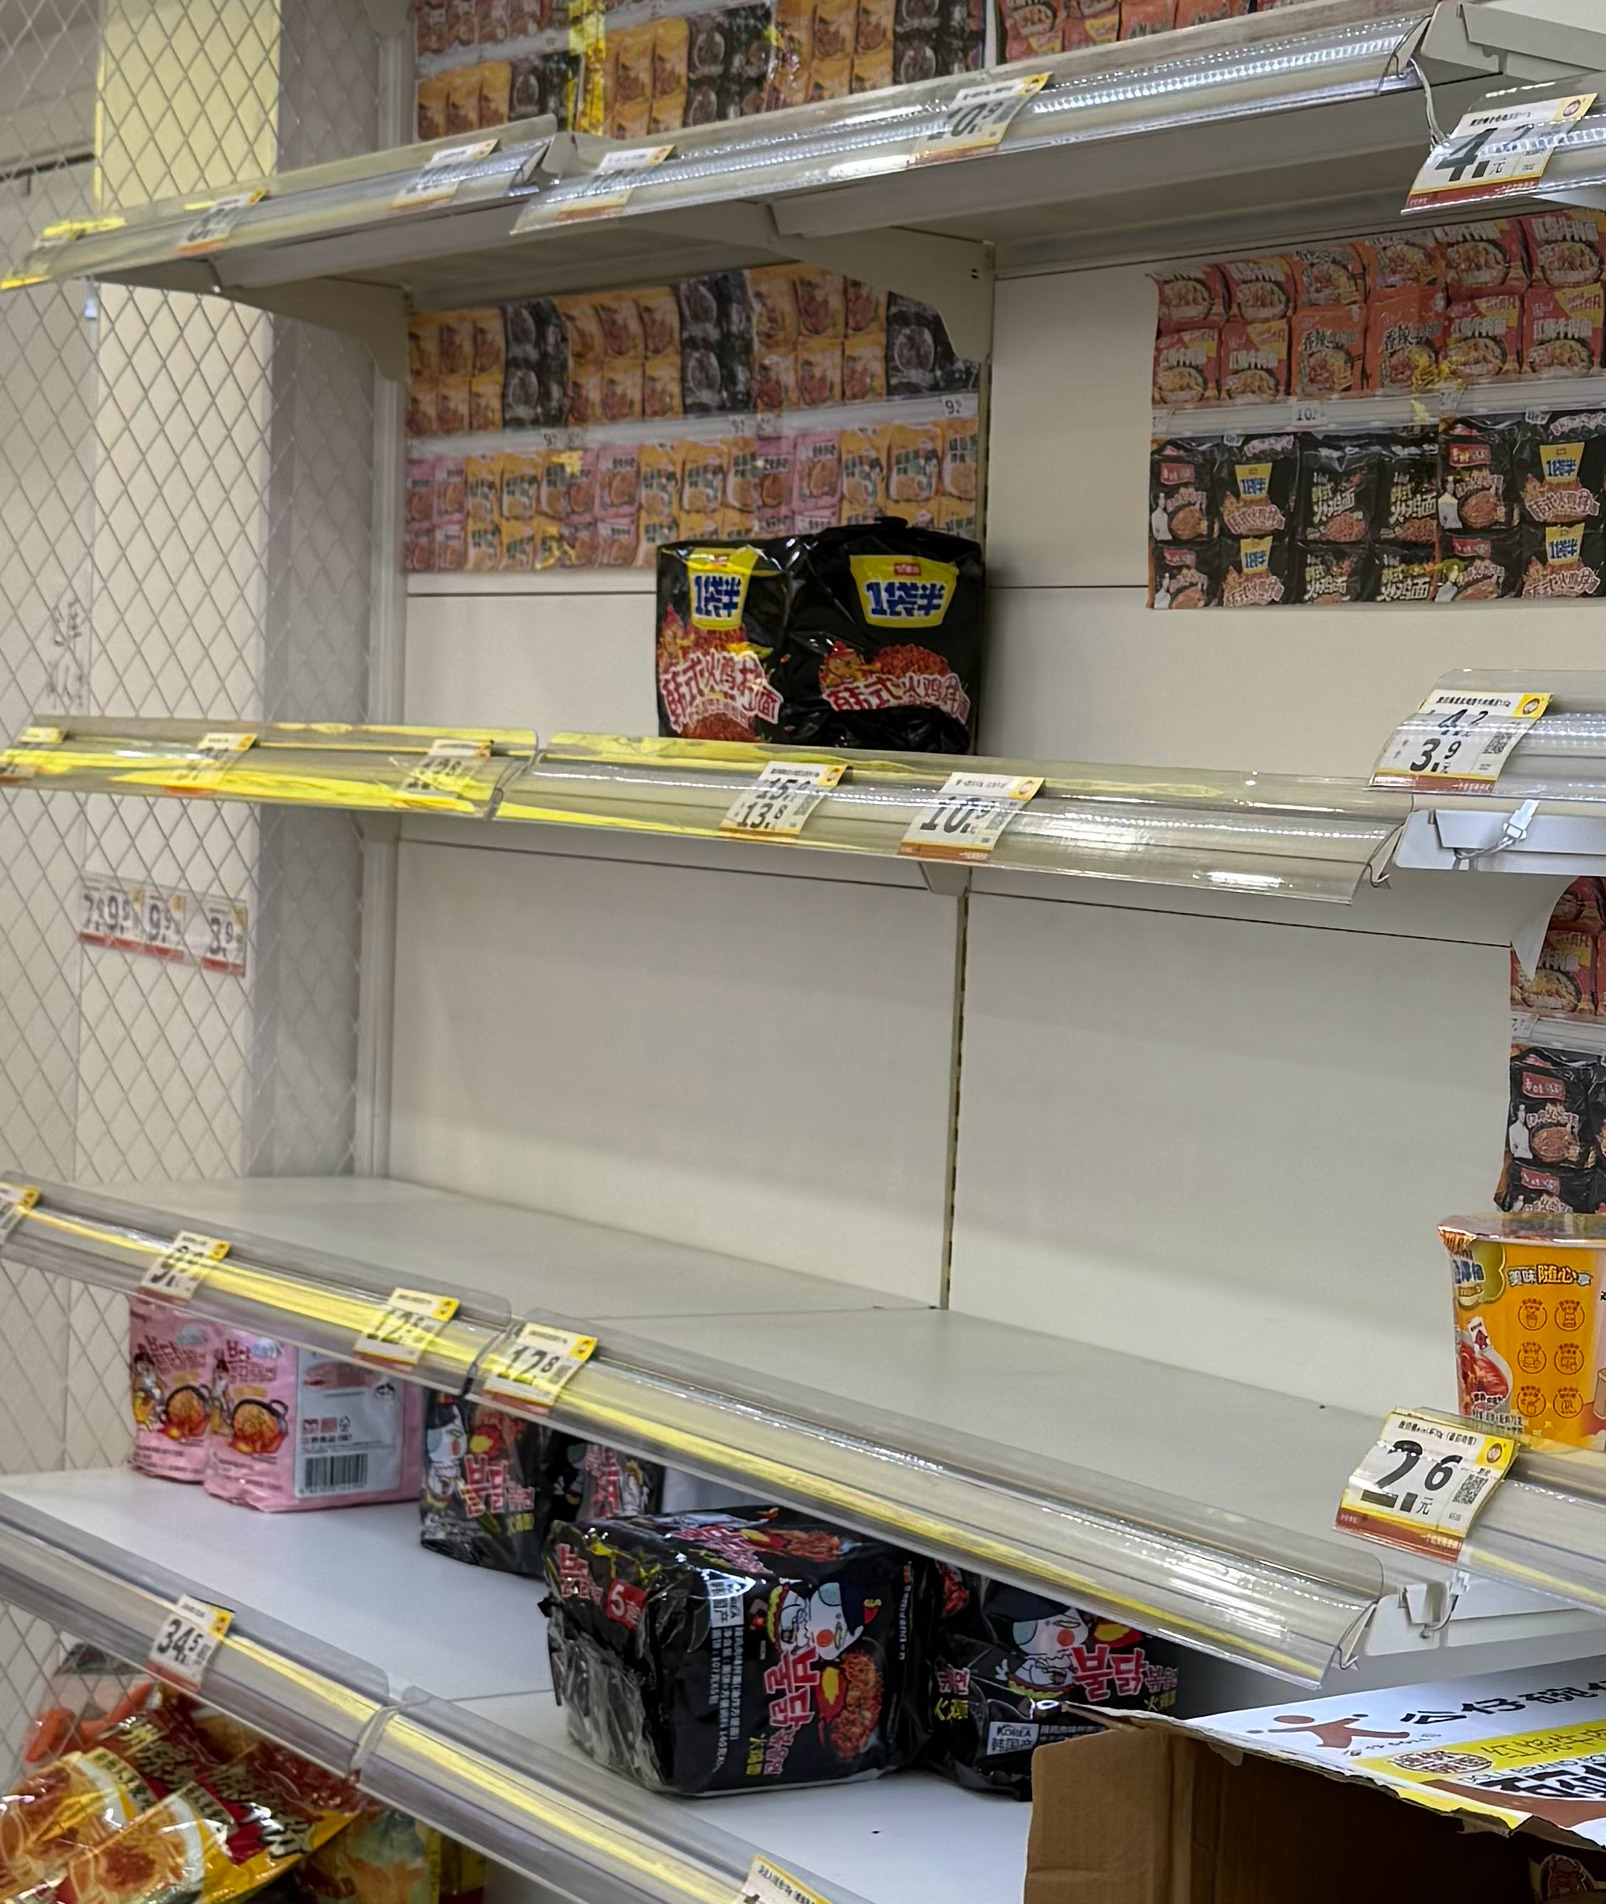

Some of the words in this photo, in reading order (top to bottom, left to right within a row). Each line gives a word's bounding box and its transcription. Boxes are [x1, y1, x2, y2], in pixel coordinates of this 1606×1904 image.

[866, 580, 948, 618] 1袋半
[1409, 738, 1462, 772] 3.9
[1360, 1439, 1463, 1513] 2.6
[1416, 1496, 1434, 1515] 元
[156, 1617, 204, 1664] 34.5
[997, 1726, 1032, 1738] KOREA
